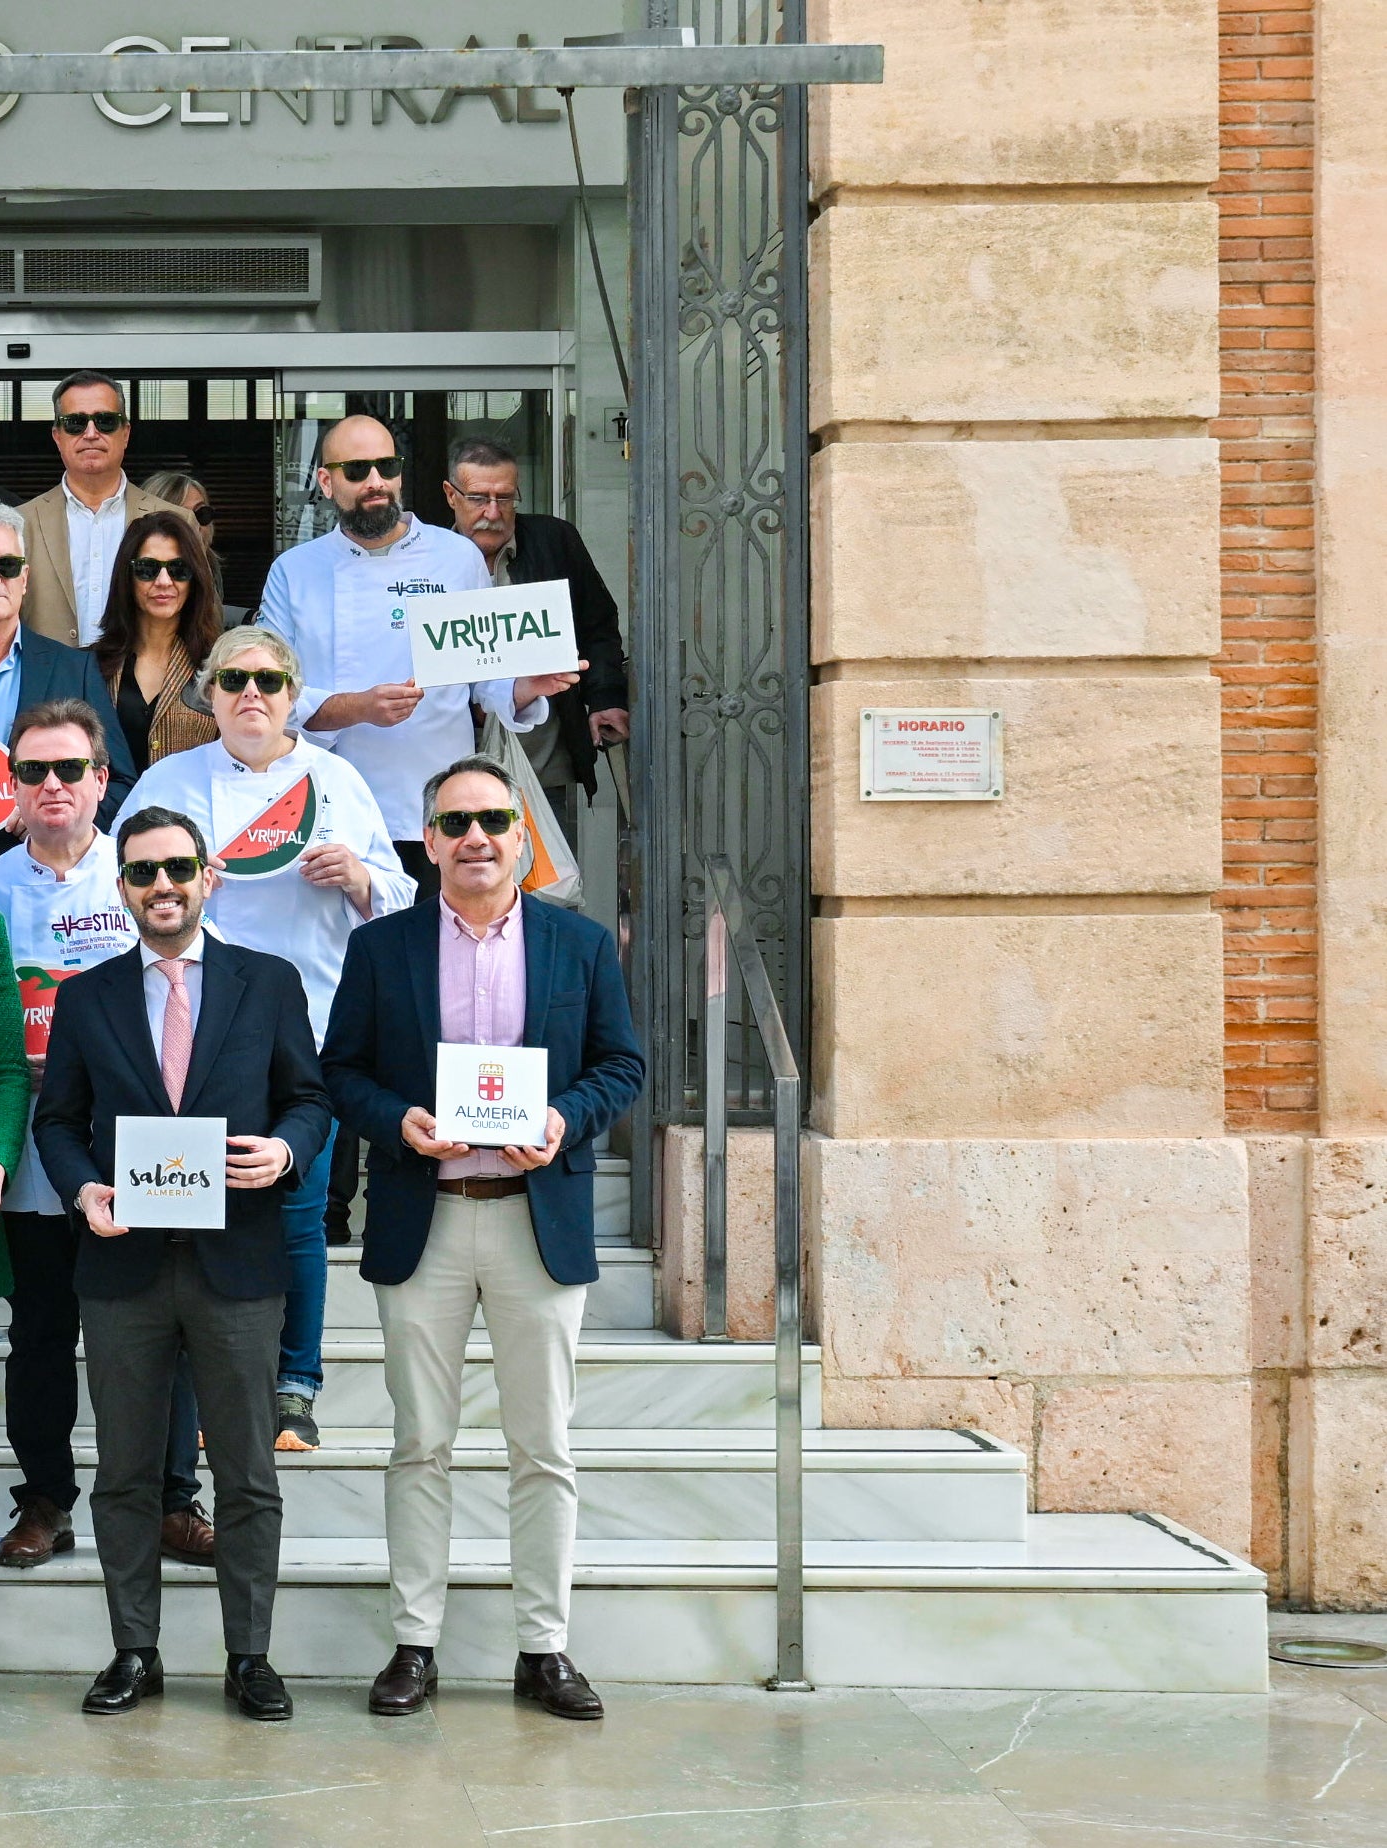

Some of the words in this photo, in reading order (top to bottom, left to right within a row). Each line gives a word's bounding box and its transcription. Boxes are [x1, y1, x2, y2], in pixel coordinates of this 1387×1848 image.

[92, 33, 561, 128] CENTRAL
[422, 609, 561, 654] VRUTAL
[476, 656, 502, 666] 2026
[898, 720, 965, 732] HORARIO
[455, 1105, 529, 1121] ALMERÍA
[471, 1119, 510, 1130] CIUDAD
[129, 1163, 211, 1188] sabores
[146, 1188, 193, 1197] ALMERÍA
